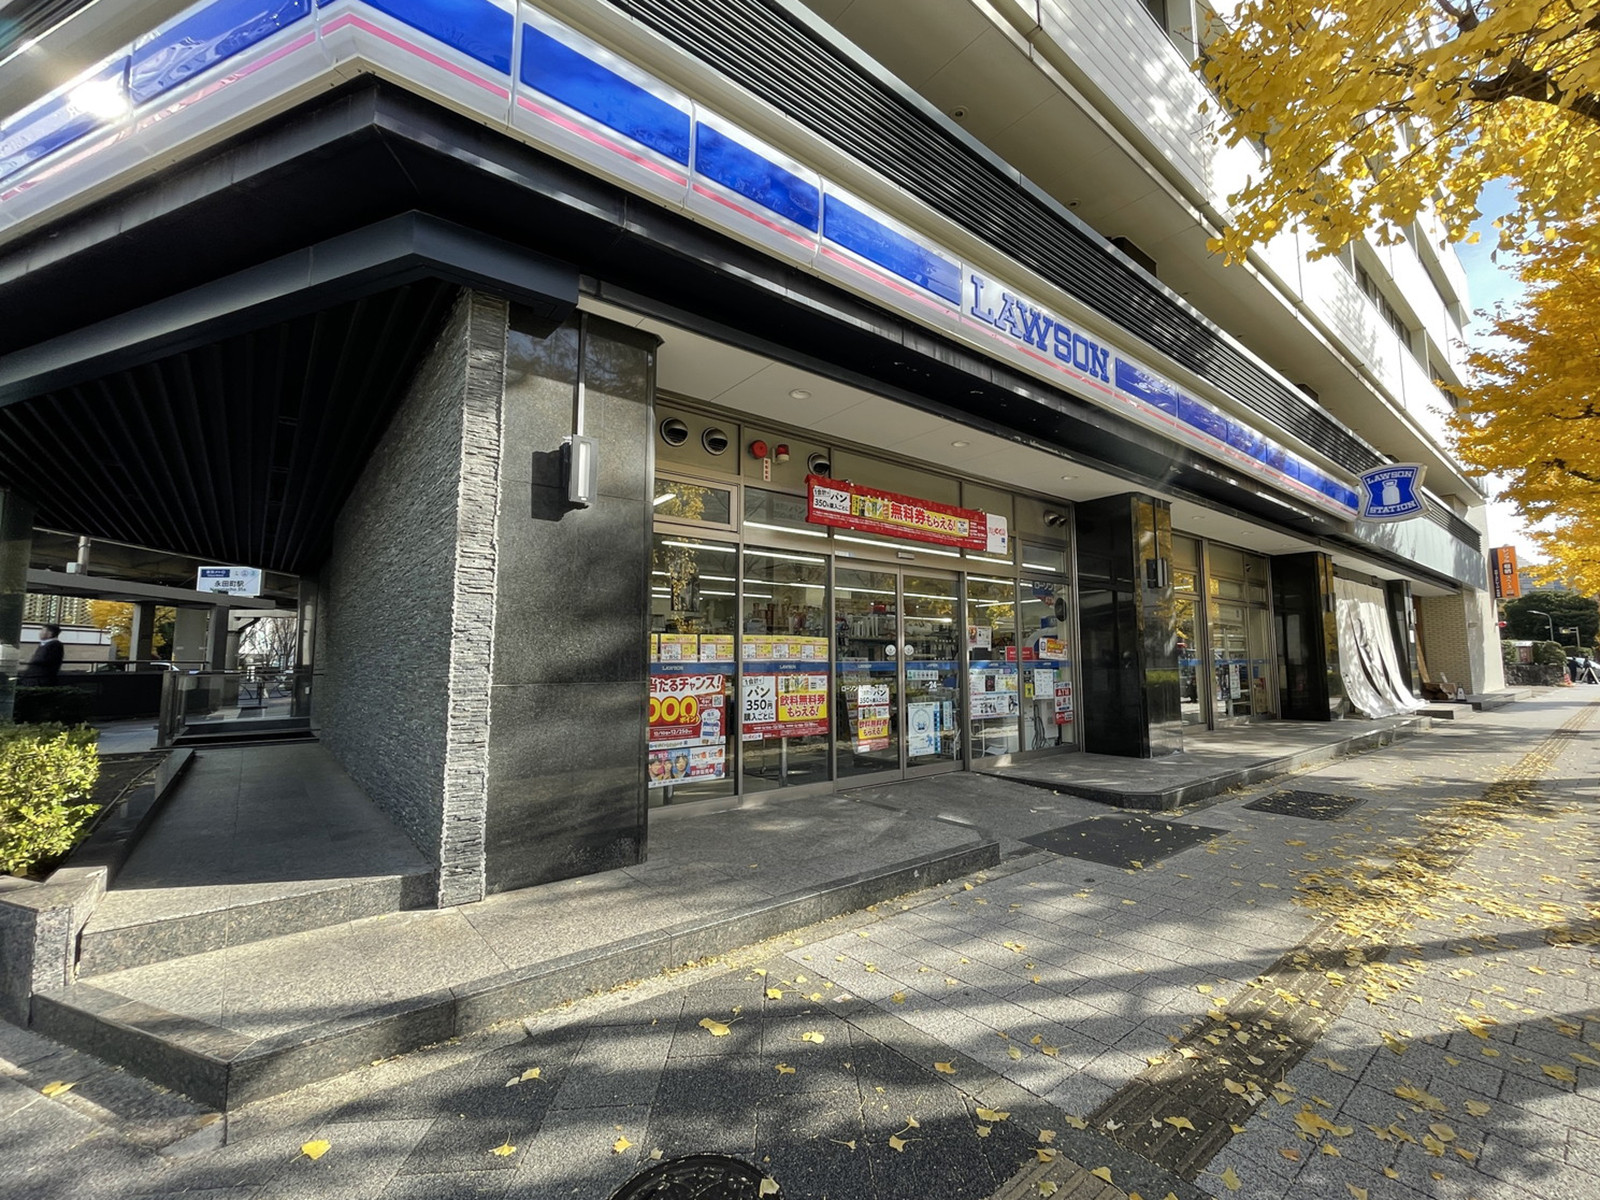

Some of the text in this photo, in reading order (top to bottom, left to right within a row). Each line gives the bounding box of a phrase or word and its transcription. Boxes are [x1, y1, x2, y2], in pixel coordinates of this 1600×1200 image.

[971, 275, 1109, 383] LAWSON
[1367, 471, 1413, 484] LAWSON
[831, 493, 848, 503] パン
[1370, 500, 1416, 513] STATION
[1034, 582, 1054, 591] ローソン
[747, 686, 771, 698] パン
[1058, 688, 1069, 696] ATM
[746, 699, 773, 711] 350円
[780, 694, 825, 706] 飲料無料券
[744, 712, 774, 721] 購入ごとに
[787, 705, 819, 717] もらえる!
